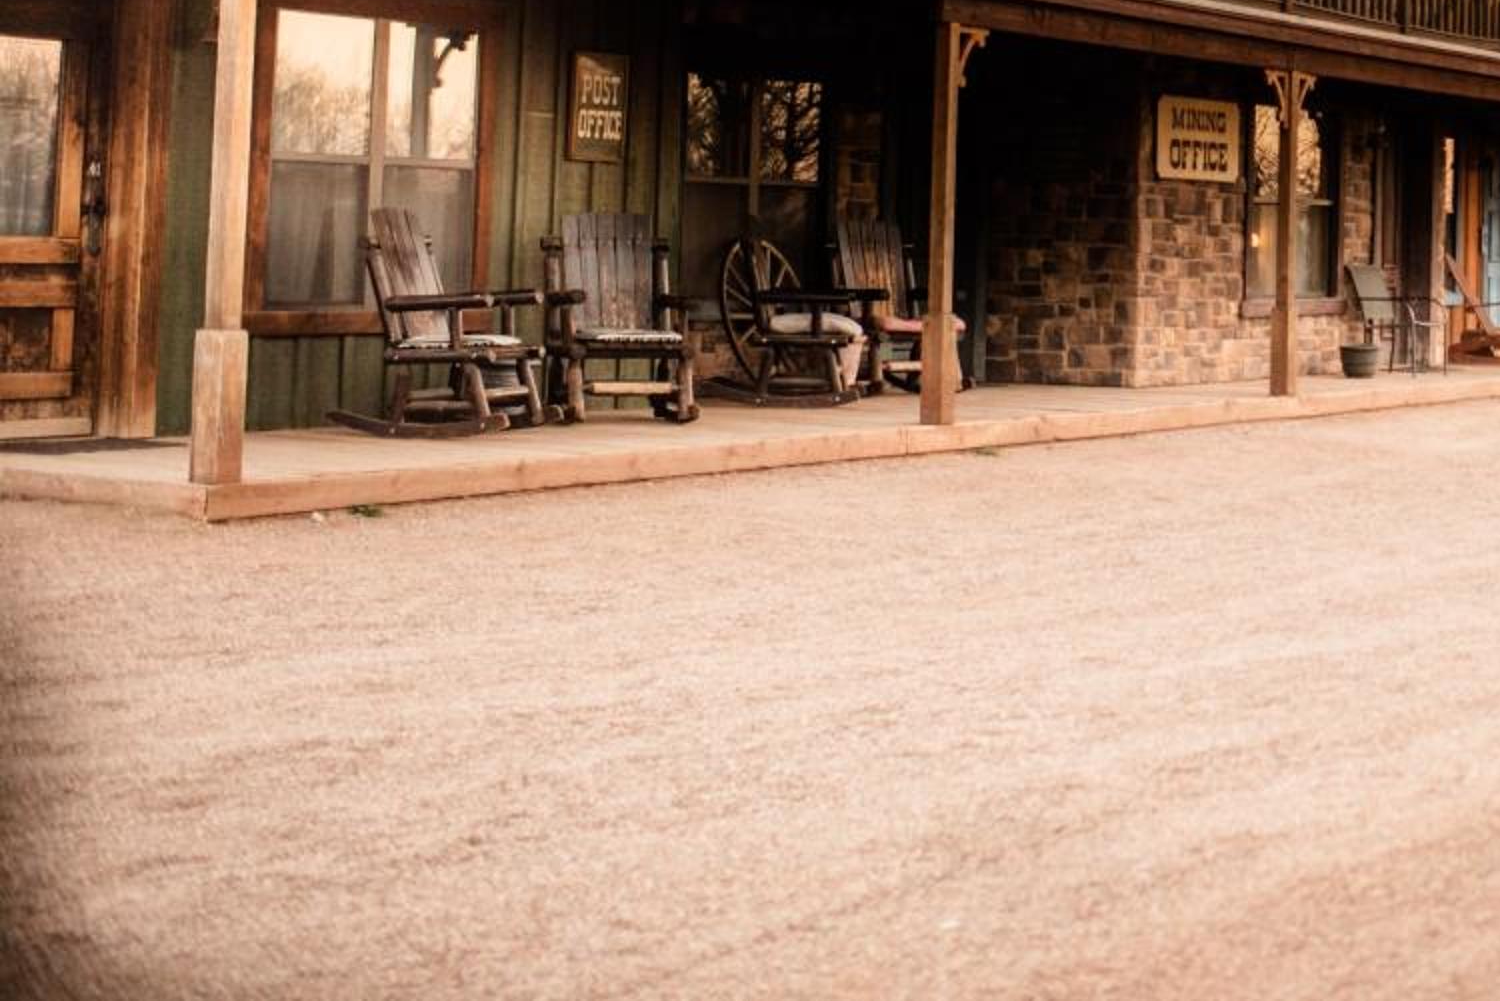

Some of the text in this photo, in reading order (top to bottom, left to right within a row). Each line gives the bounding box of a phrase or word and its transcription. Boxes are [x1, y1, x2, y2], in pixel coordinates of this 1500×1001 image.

[581, 75, 621, 106] POST
[578, 109, 622, 141] OFFICE
[1171, 106, 1227, 134] MINING
[1169, 138, 1229, 172] OFFICE
